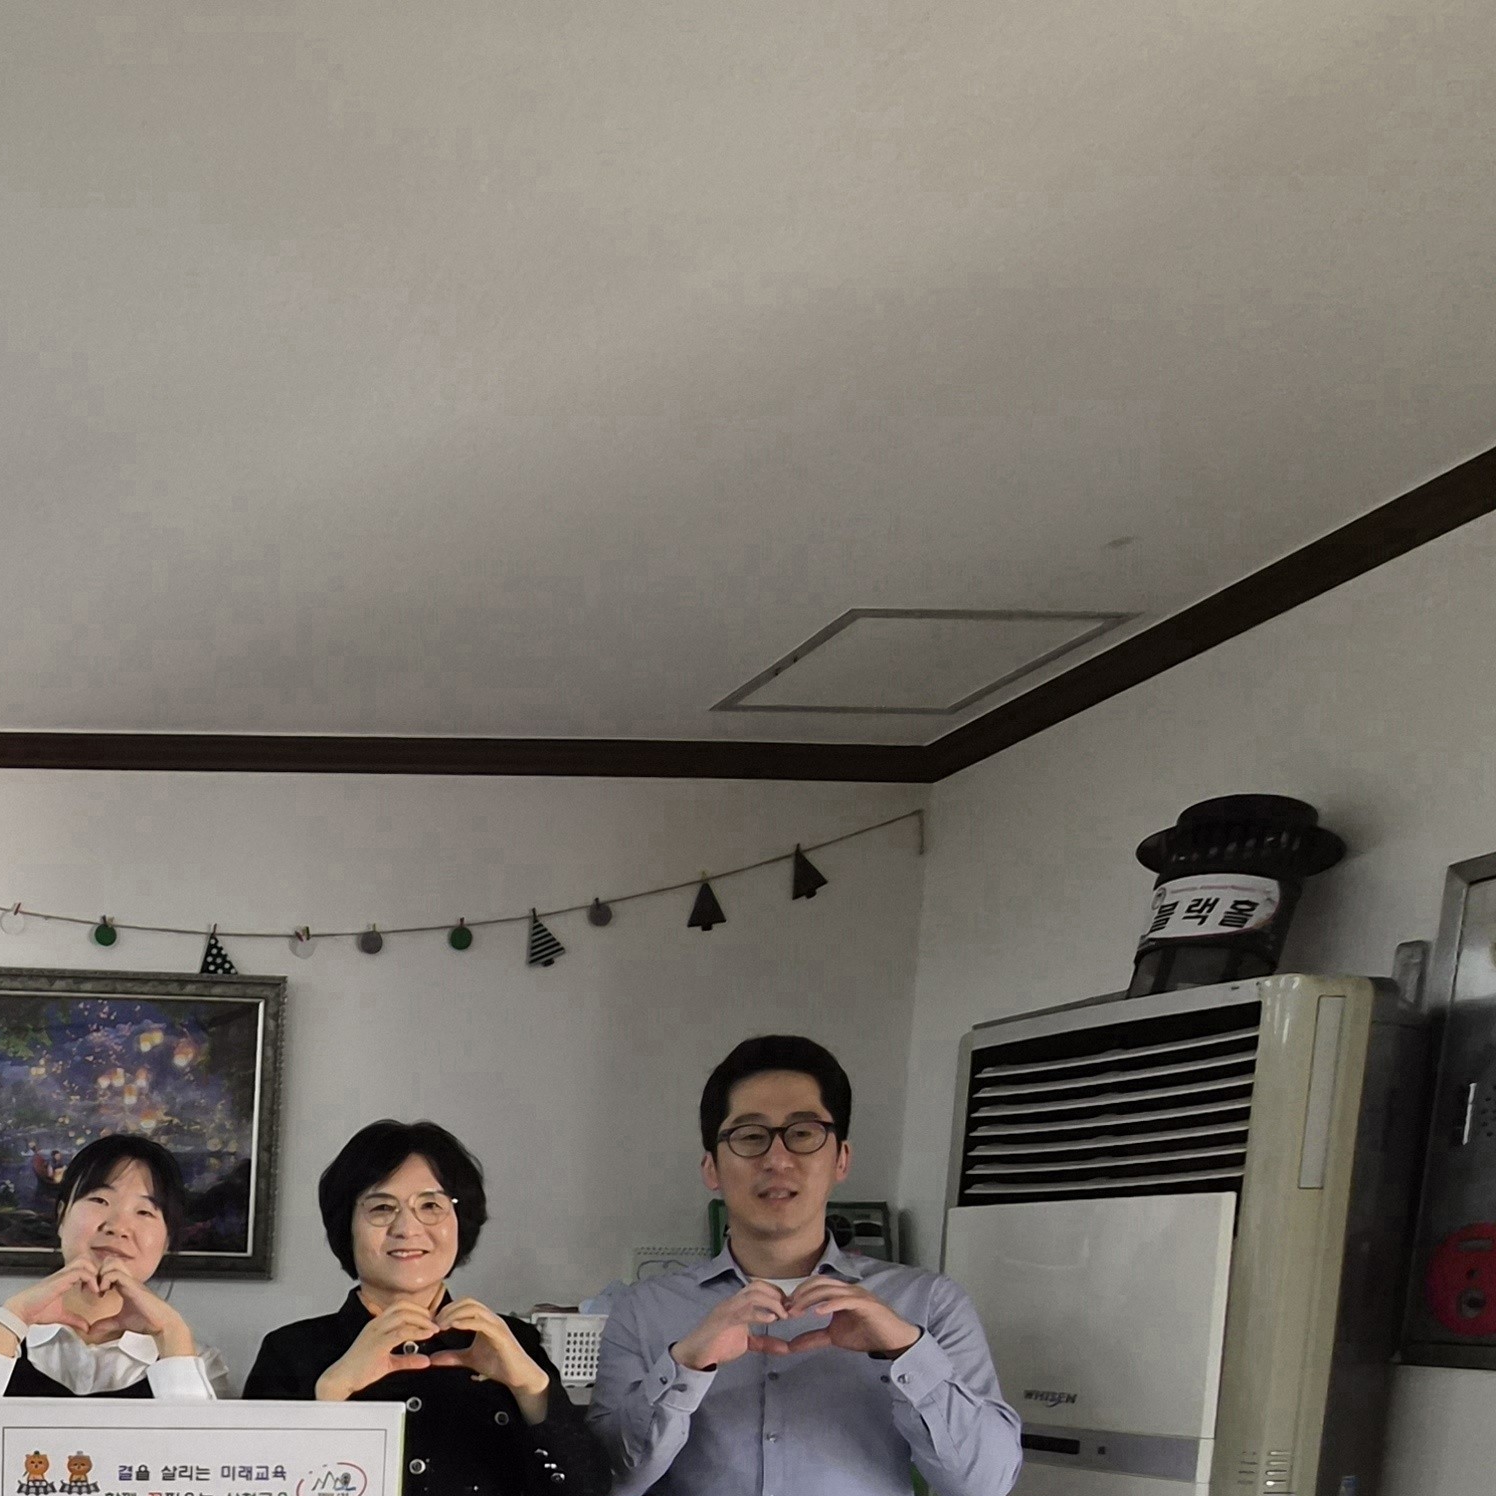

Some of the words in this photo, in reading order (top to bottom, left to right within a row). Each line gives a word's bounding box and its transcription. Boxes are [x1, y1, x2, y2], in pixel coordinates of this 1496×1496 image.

[1149, 897, 1260, 933] 블랙홀
[117, 1464, 150, 1482] 결을
[161, 1464, 211, 1482] 살리는
[220, 1464, 287, 1482] 미래교육
